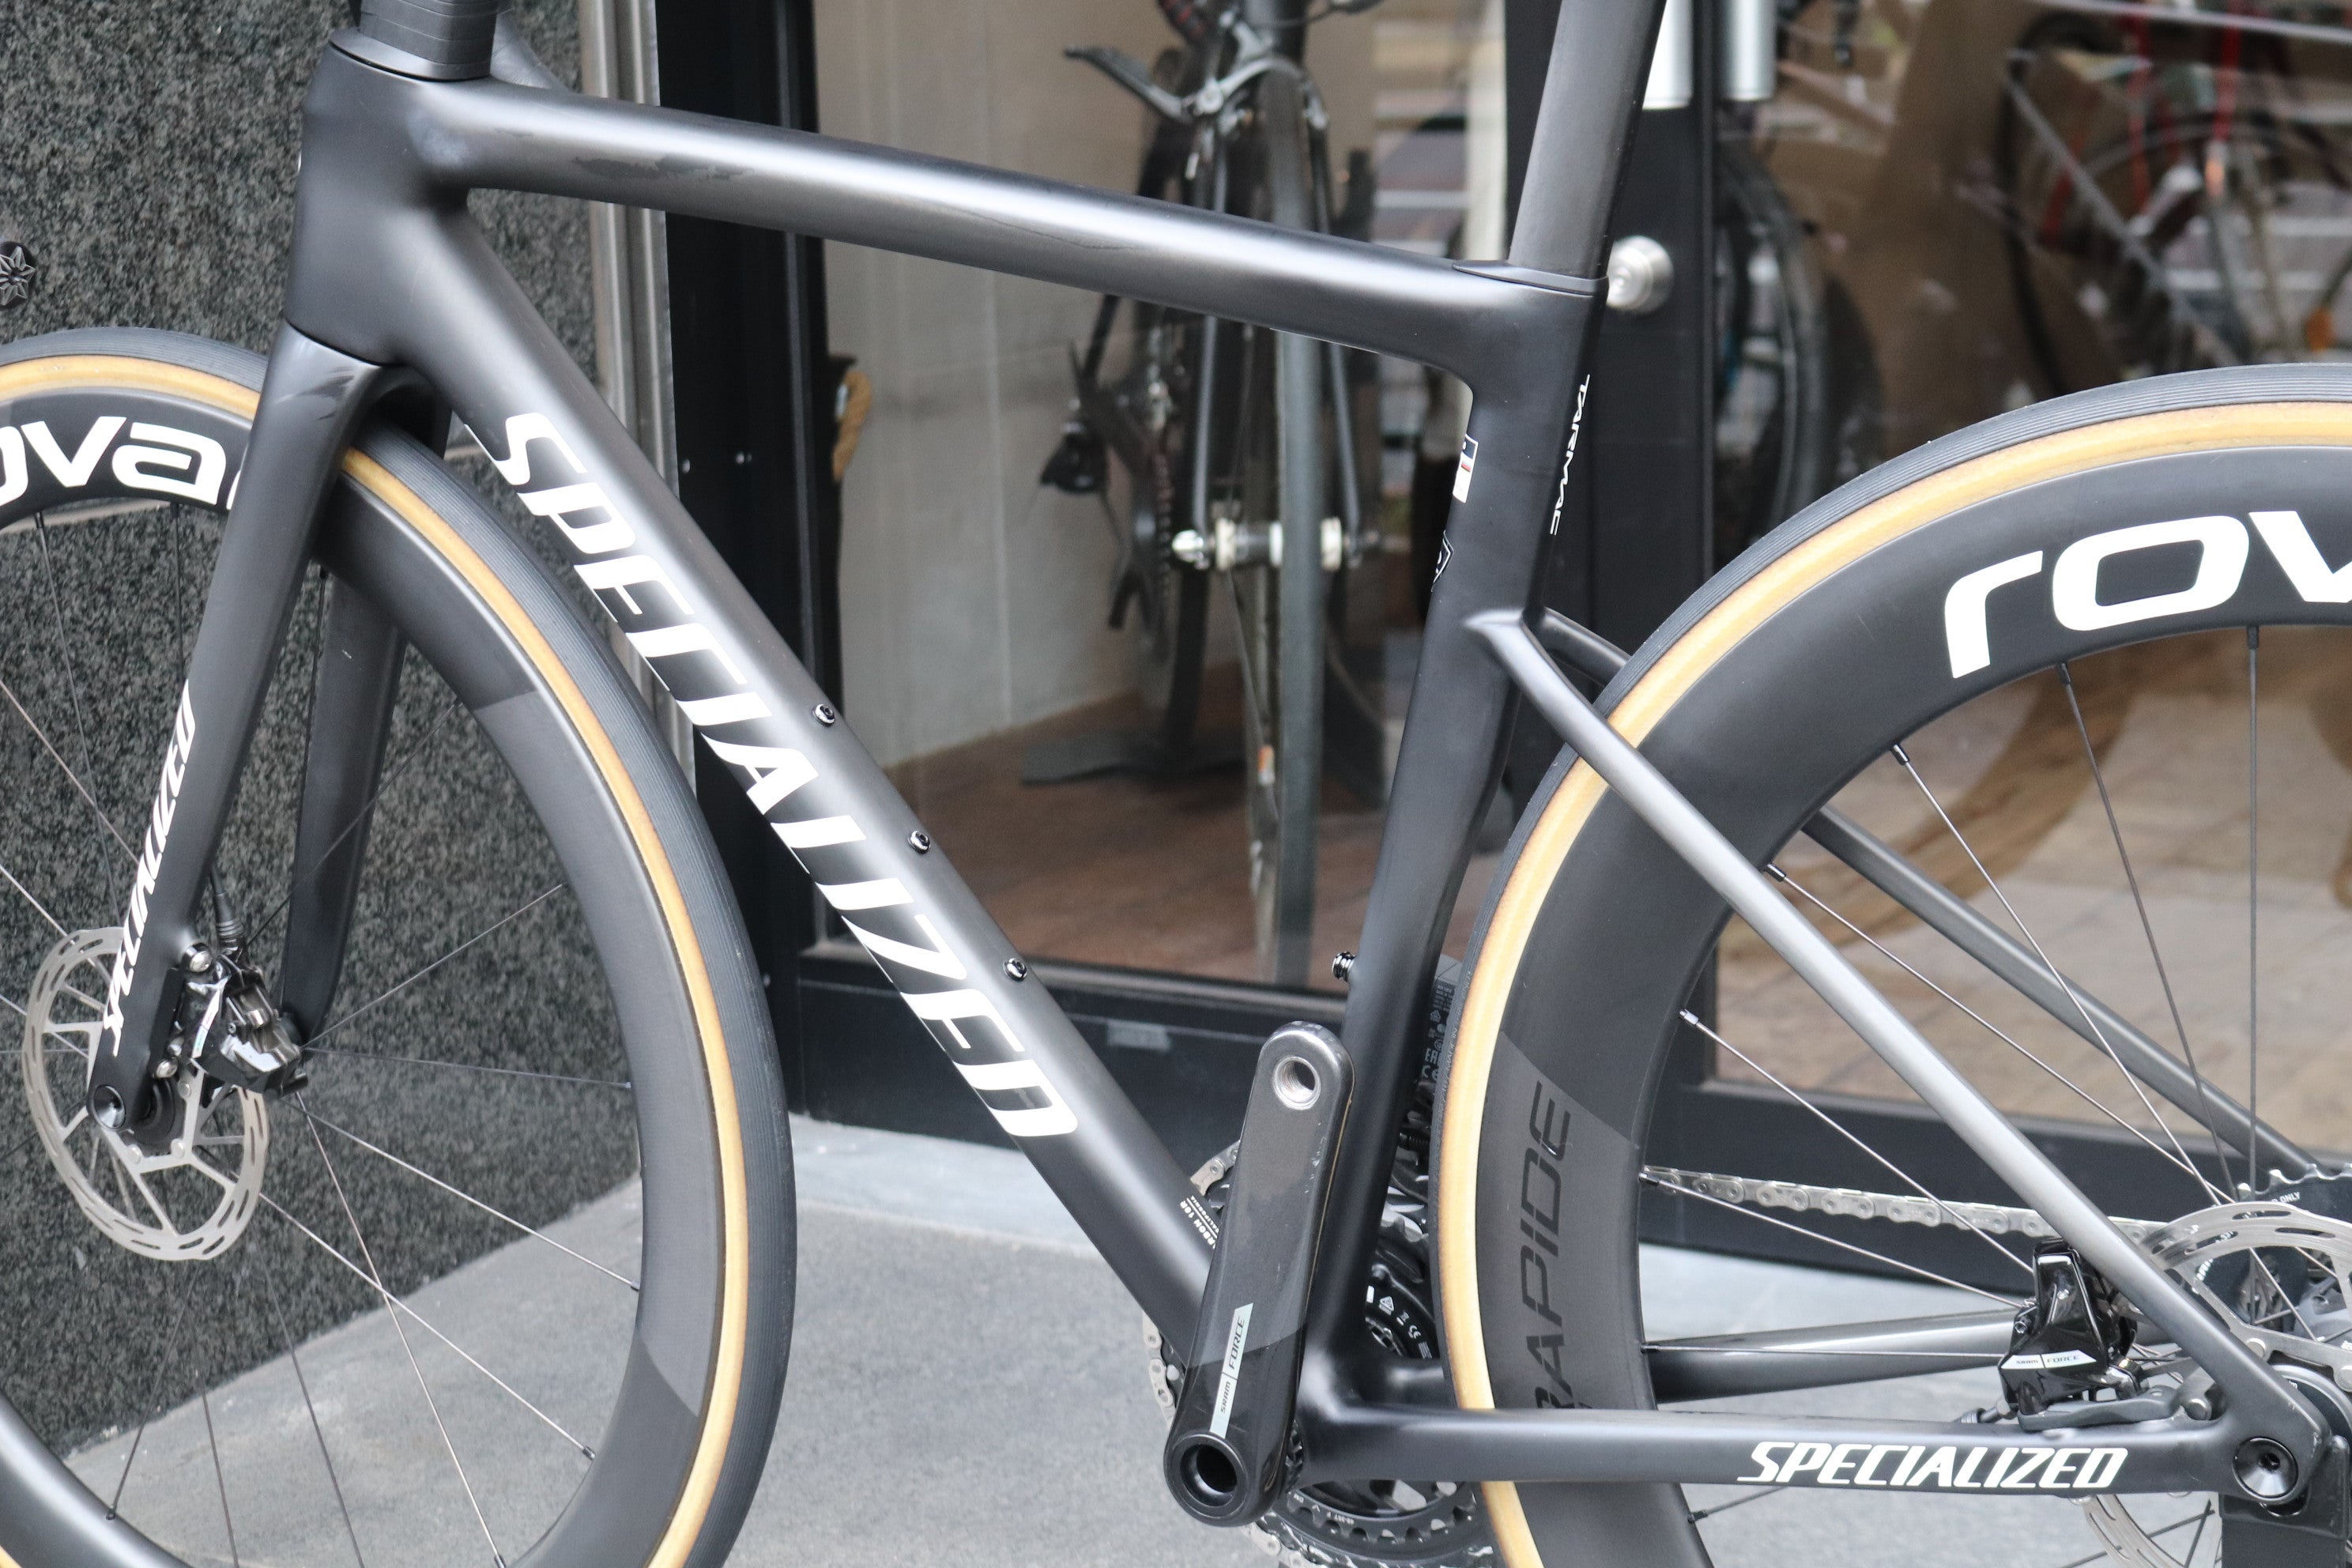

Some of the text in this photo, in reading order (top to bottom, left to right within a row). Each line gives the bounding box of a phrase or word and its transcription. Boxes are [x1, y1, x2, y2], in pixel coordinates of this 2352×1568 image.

[0, 416, 242, 511] va
[1550, 374, 1590, 535] TARMAC
[465, 412, 1078, 1136] SPECIALIZED
[1193, 1219, 1216, 1250] RBON
[1220, 1314, 1245, 1413] SRAM FORCE
[2047, 1354, 2080, 1364] FORCE
[1737, 1442, 2128, 1489] SPECIALIZED
